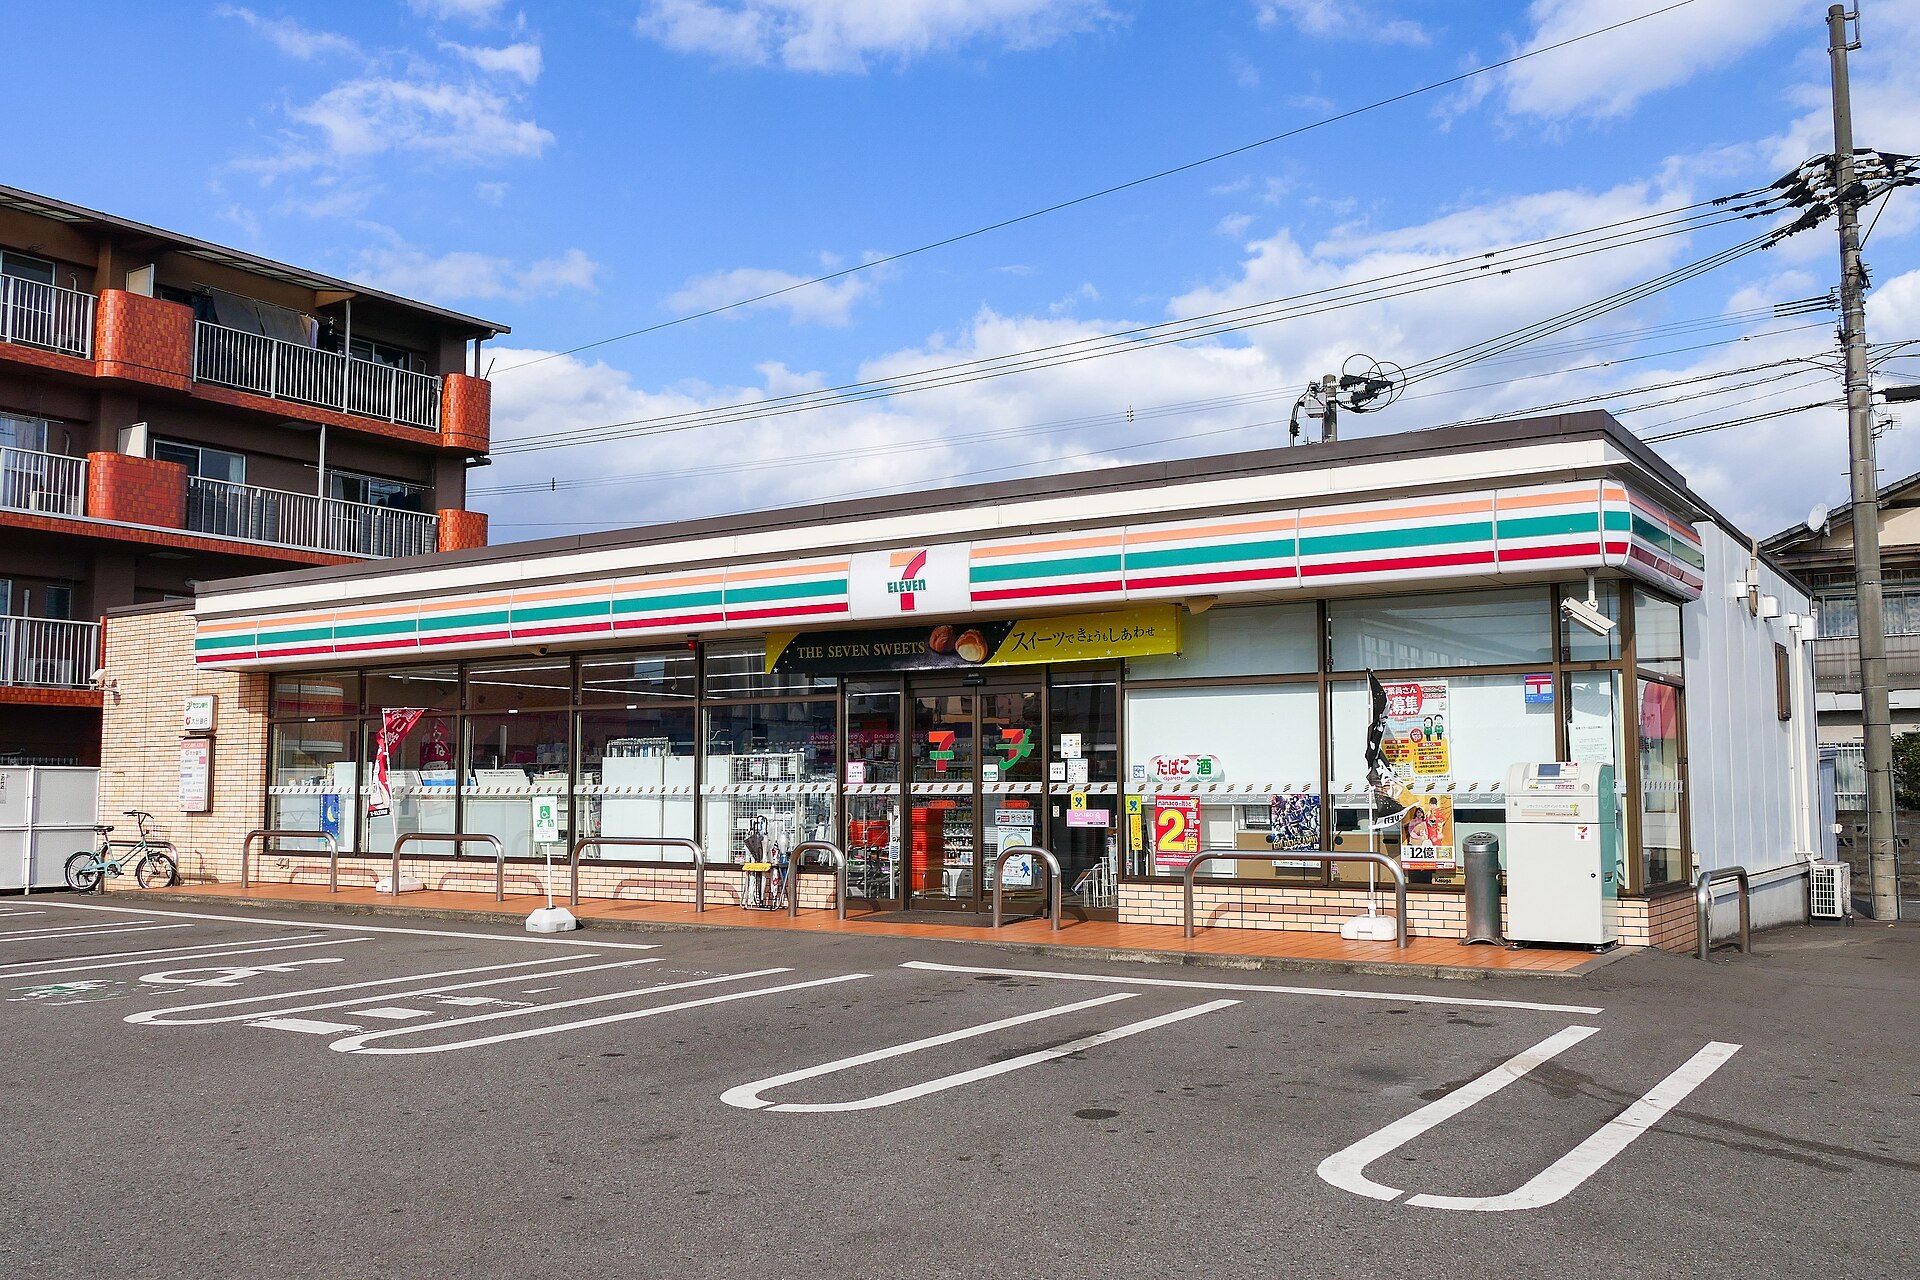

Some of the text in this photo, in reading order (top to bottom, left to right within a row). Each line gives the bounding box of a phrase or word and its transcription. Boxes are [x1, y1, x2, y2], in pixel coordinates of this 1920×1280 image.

[889, 549, 927, 611] 7
[1012, 626, 1155, 651] スイーツできょうもしあわせ
[797, 642, 925, 658] THE SEVEN SWEETS
[1157, 759, 1212, 775] たばこ 酒
[1158, 809, 1185, 851] 2
[1185, 838, 1198, 852] 倍
[1410, 847, 1434, 859] 12億
